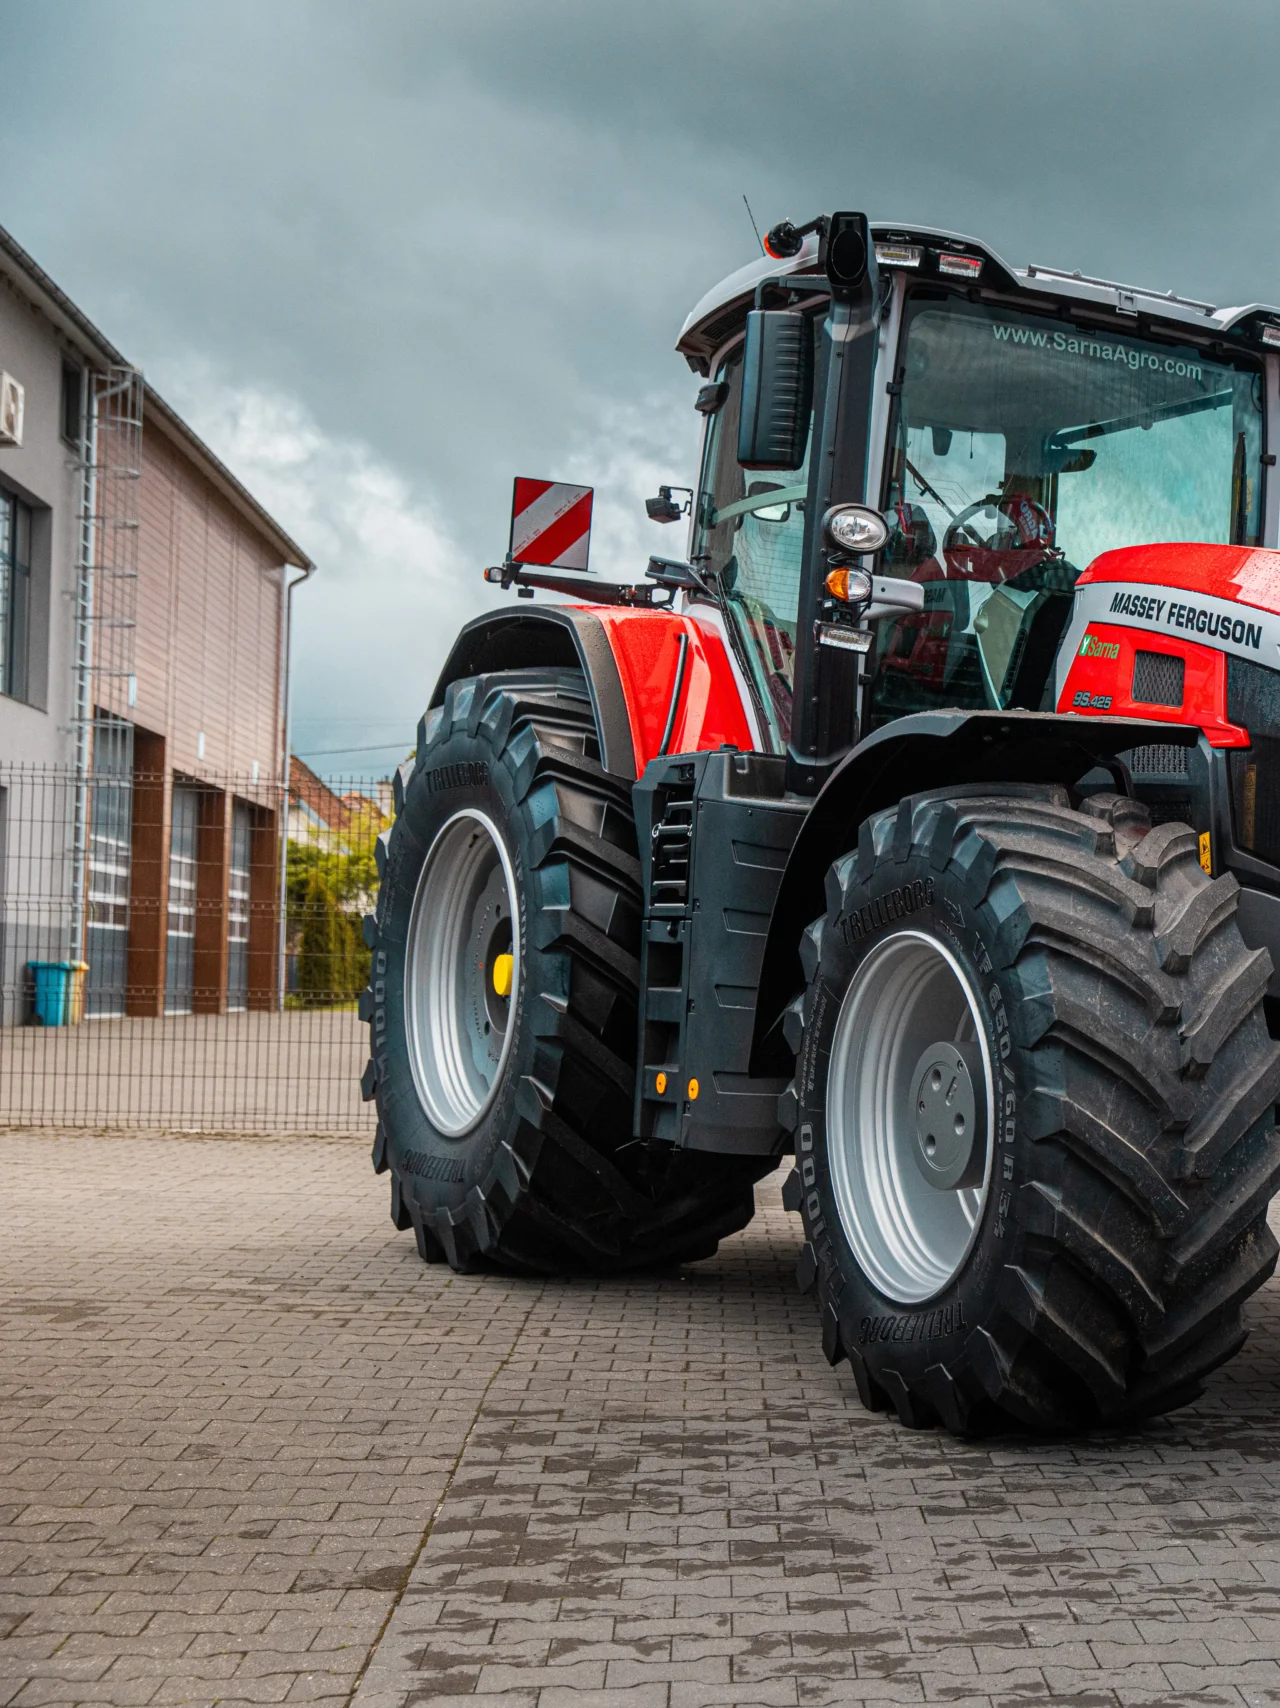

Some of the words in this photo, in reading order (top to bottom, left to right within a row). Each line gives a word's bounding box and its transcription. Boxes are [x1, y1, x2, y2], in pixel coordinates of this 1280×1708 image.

[992, 325, 1202, 380] www.SarnaAgro.com
[1087, 636, 1121, 659] Sarna
[1109, 592, 1166, 622] MASSEY
[1167, 602, 1263, 649] FERGUSON
[425, 760, 488, 795] TRELLEBORG
[840, 876, 935, 947] TRELLEBORG
[988, 983, 1016, 1144] 650/60
[403, 1149, 465, 1183] TRELLEBORG
[799, 1121, 847, 1308] TM1000
[859, 1300, 969, 1344] TRELLEBORG
